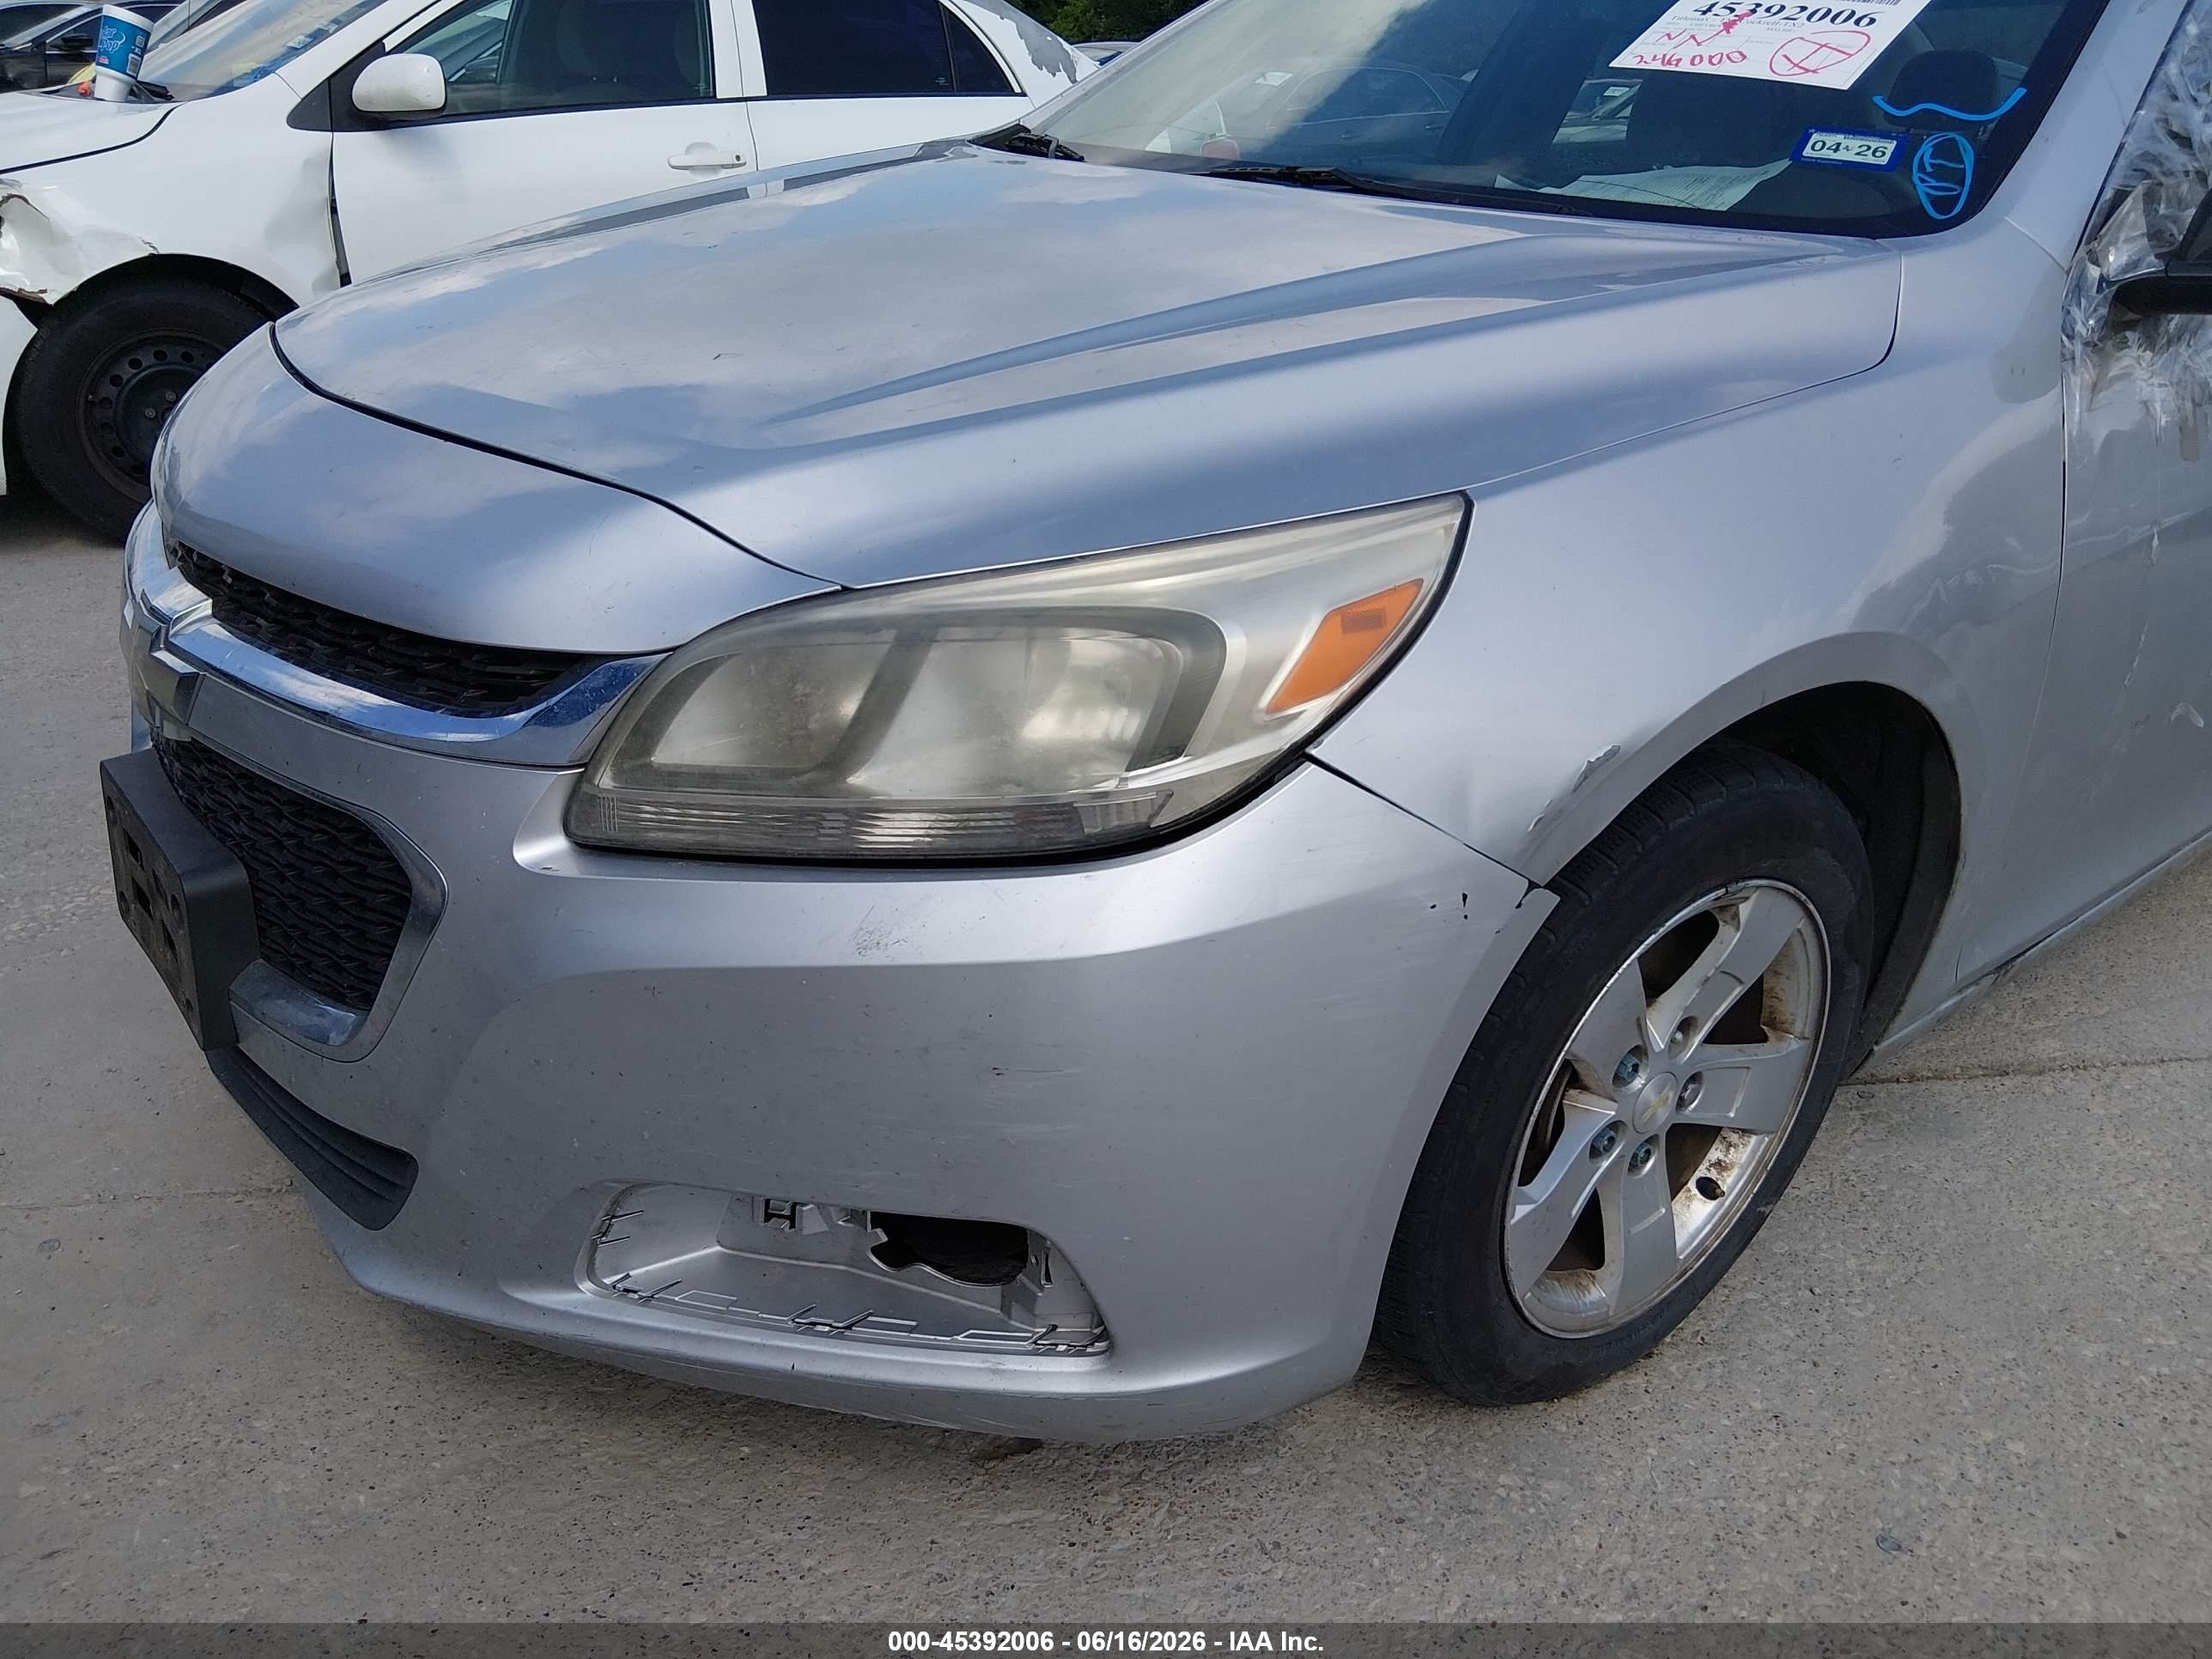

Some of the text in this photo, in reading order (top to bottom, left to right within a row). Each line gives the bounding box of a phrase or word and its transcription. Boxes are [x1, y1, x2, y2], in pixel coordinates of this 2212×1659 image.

[1692, 2, 1886, 27] 45392006
[1811, 140, 1887, 158] 04 26
